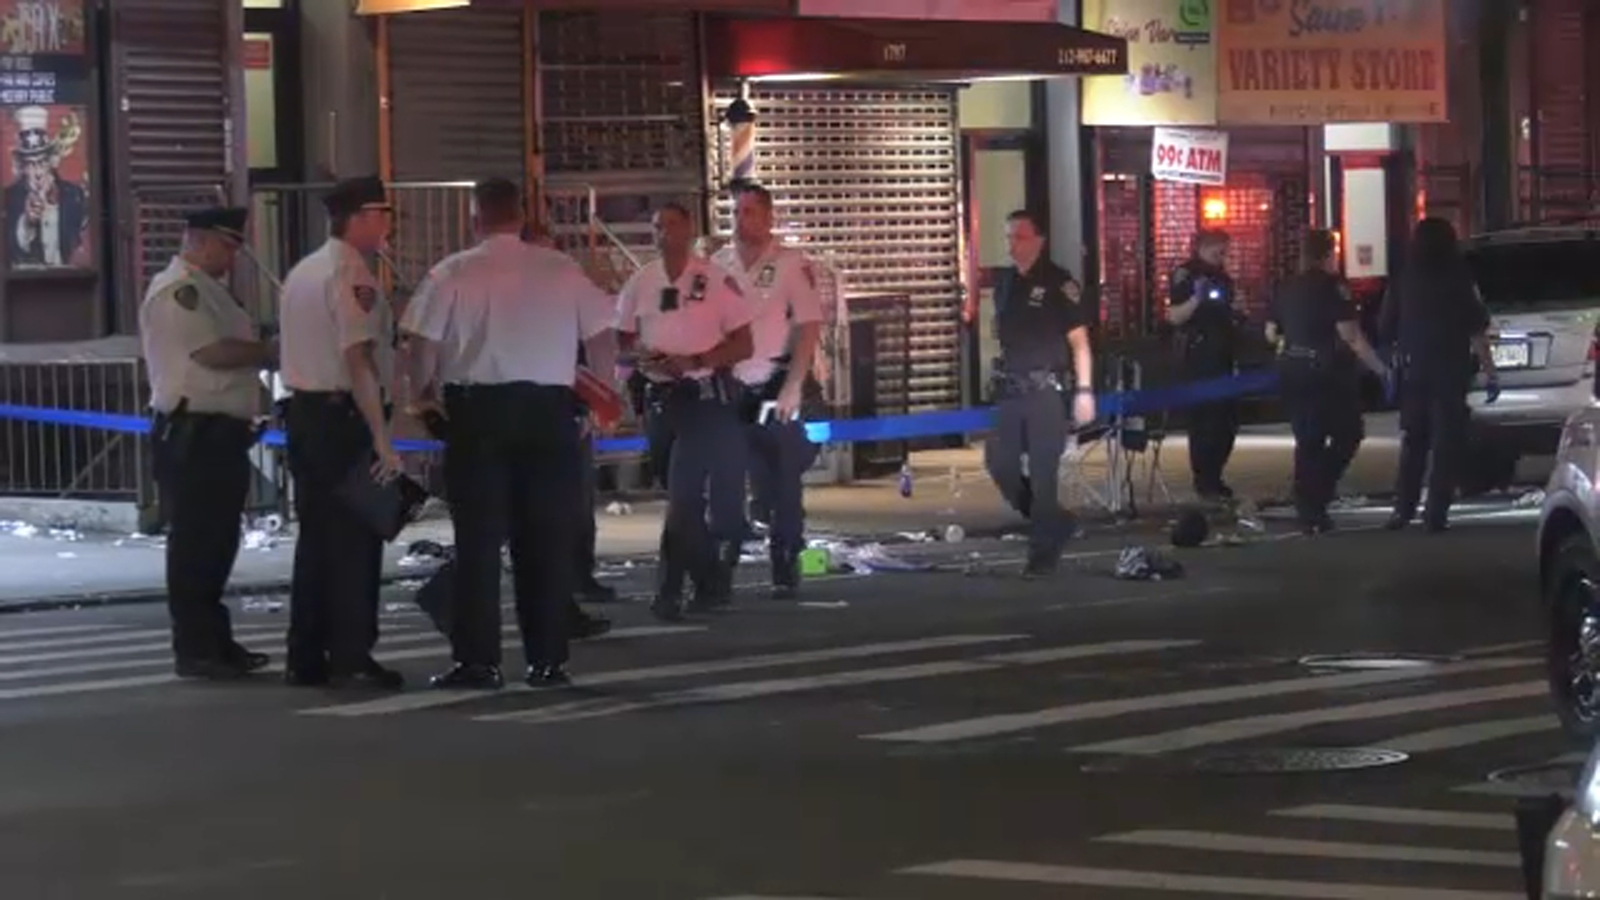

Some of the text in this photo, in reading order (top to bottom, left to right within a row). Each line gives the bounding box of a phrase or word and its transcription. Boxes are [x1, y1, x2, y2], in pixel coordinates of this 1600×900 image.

[1229, 48, 1340, 91] VARIETY
[1351, 48, 1437, 91] STORE
[1185, 147, 1223, 173] ATM
